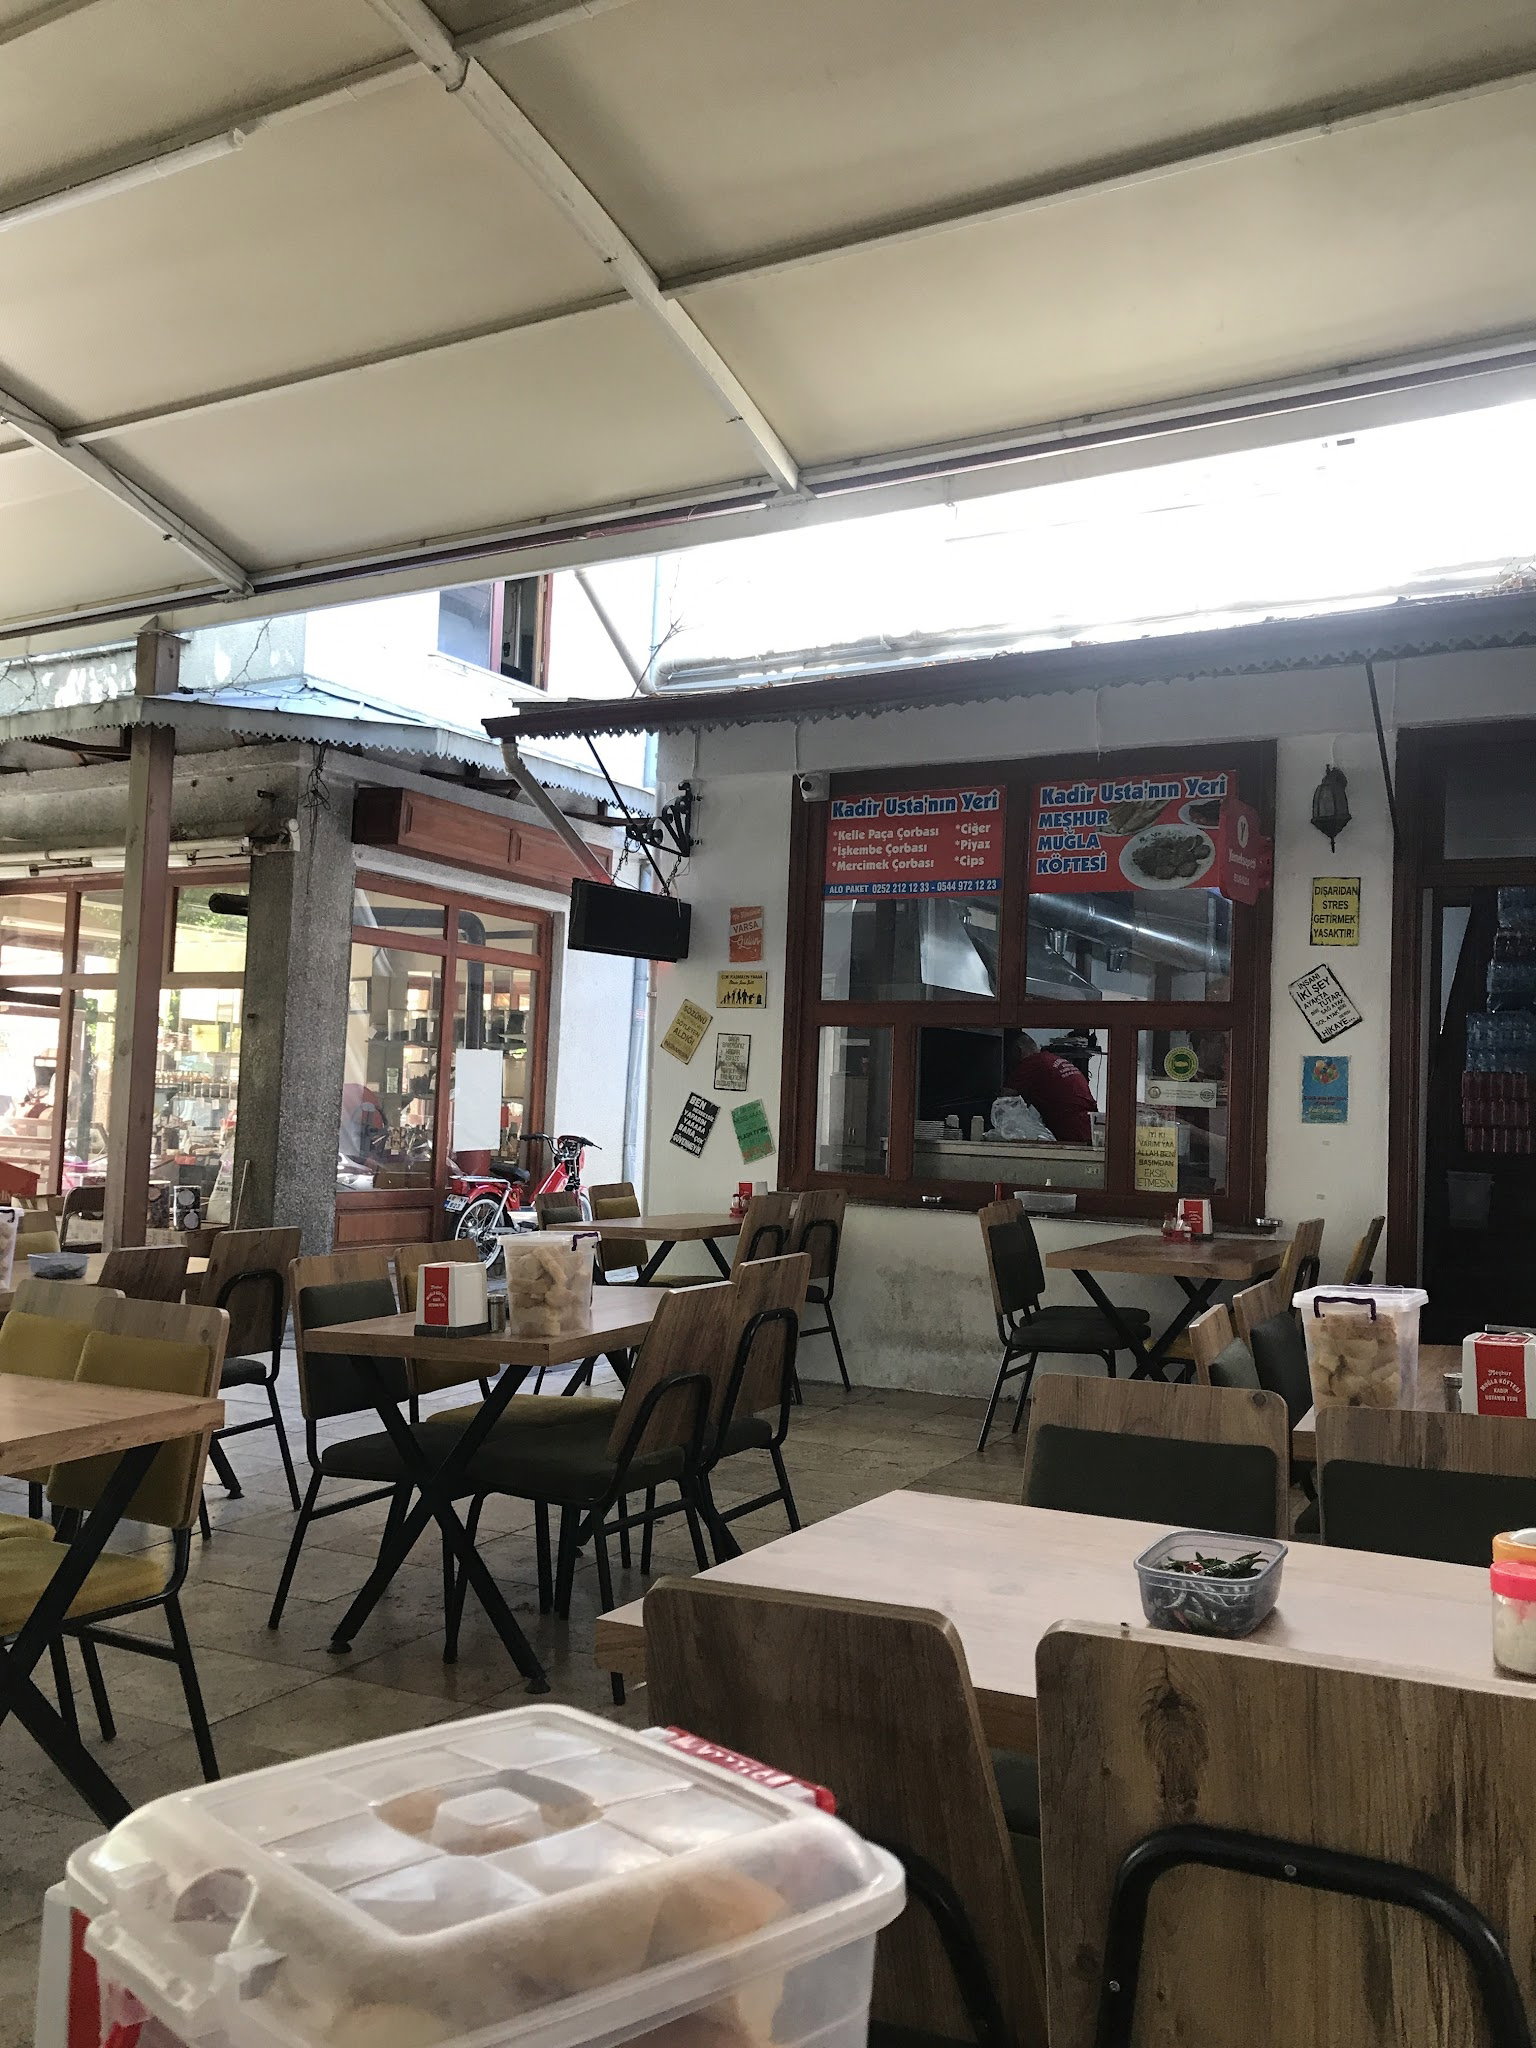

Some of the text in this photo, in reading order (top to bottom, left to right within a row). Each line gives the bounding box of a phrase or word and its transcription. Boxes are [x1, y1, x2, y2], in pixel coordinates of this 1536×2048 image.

[1042, 774, 1227, 806] Kadir Usta'nın Yeri
[832, 790, 1000, 819] Kadir Usta'nın Yeri
[1038, 811, 1109, 831] MEŞHUR
[868, 829, 894, 842] Paça
[896, 827, 939, 841] Çorbası
[1037, 829, 1100, 852] MUĞLA
[885, 843, 928, 857] Çorbası
[892, 858, 935, 872] Çorbası
[1036, 852, 1107, 874] KÖFTESİ
[829, 885, 844, 894] ALO
[845, 884, 869, 893] PAKET
[872, 883, 891, 894] 0252
[892, 883, 907, 893] 212
[908, 882, 918, 892] 12
[919, 881, 930, 892] 33
[937, 881, 956, 892] 0544
[957, 880, 973, 891] 972
[975, 879, 985, 890] 12
[986, 879, 997, 890] 23
[1314, 886, 1358, 897] DIŞARIDAN
[1322, 900, 1349, 909] STRES
[1313, 912, 1356, 924] GETİRMEK
[732, 921, 759, 934] VARSA
[1313, 928, 1355, 938] YASAKTIR!
[1312, 976, 1330, 994] ŞEY
[1303, 992, 1328, 1009] AYAKTA
[1318, 991, 1341, 1007] TUTAR
[690, 1095, 707, 1110] BEN
[683, 1109, 707, 1126] YAPARIM
[678, 1123, 696, 1138] BANA
[1137, 1150, 1159, 1158] ALLAH
[1139, 1159, 1174, 1168] BAŞIMDAN
